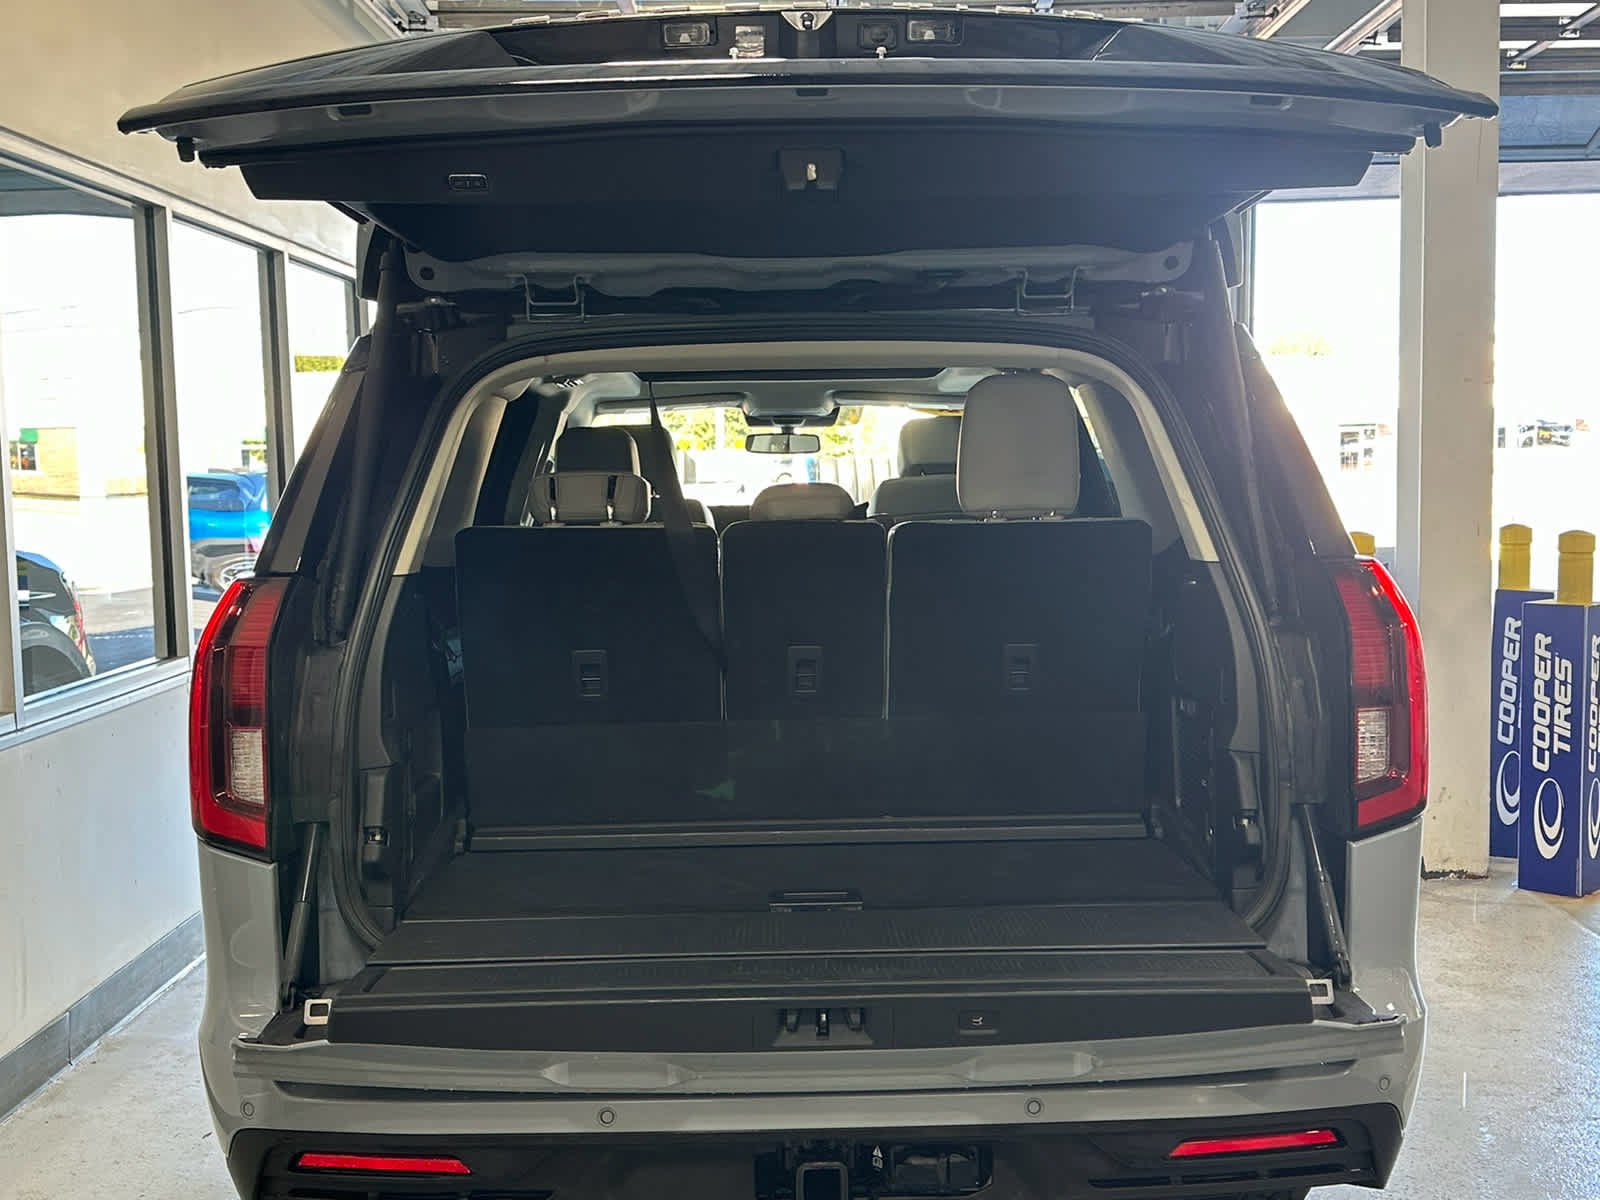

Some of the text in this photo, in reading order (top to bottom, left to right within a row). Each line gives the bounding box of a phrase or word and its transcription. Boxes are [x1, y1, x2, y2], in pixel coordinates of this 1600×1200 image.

[1497, 616, 1522, 745] COOPER
[1532, 632, 1552, 772] COOPER
[1553, 656, 1573, 755] TIRES
